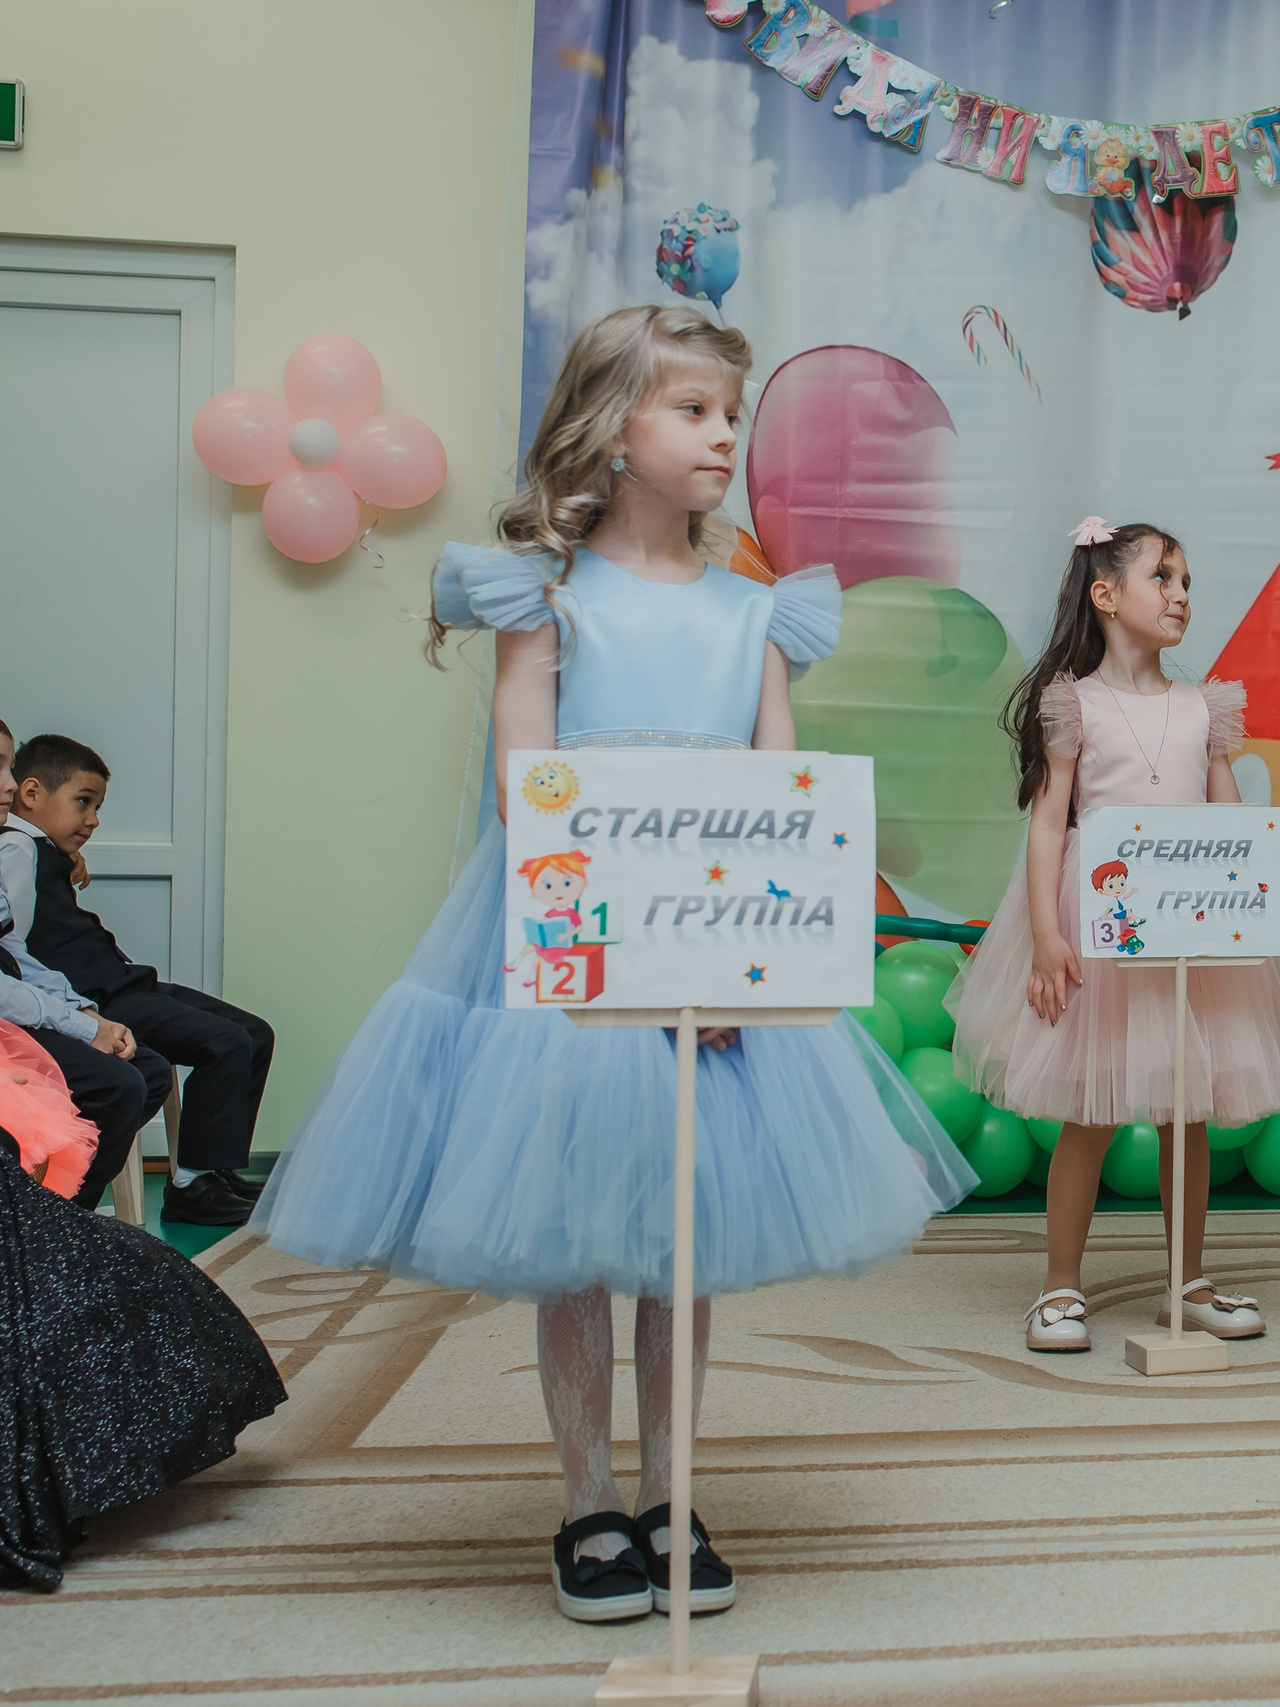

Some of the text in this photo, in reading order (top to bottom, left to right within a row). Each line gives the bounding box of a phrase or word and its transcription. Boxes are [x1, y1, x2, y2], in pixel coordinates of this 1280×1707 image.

[568, 806, 816, 840] СТАРШАЯ
[1116, 838, 1253, 862] СРЕДНЯЯ
[643, 895, 835, 927] ГРУППА
[1156, 890, 1266, 910] ГРУППА
[590, 902, 608, 936] 1
[1100, 922, 1115, 943] 3
[551, 961, 576, 995] 2
